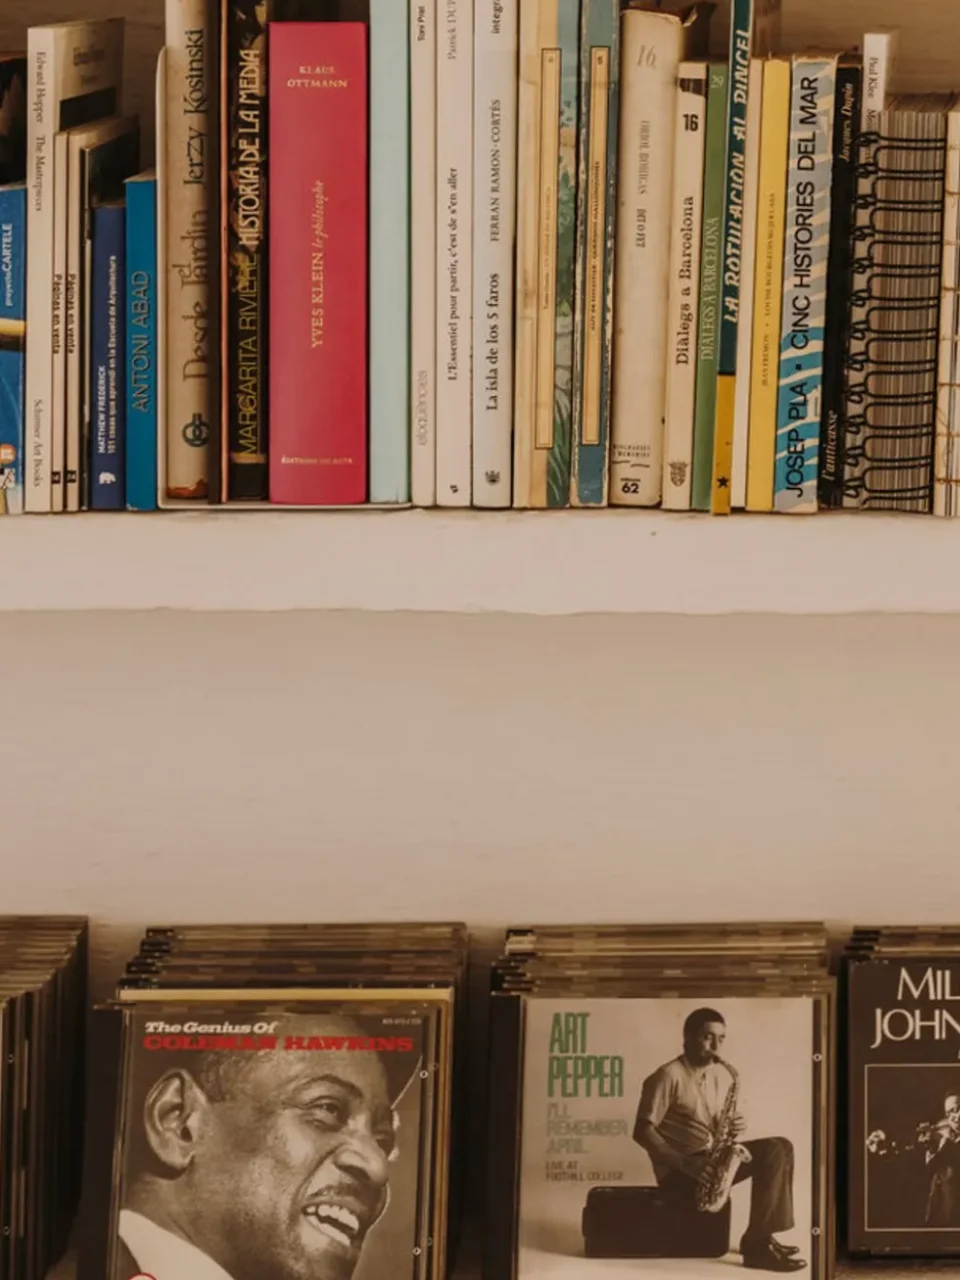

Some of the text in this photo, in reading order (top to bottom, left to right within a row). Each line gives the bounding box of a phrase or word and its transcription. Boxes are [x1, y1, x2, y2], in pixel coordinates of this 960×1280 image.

[287, 78, 348, 88] OTTMANN
[182, 28, 208, 190] Jerzy Kosinski
[682, 113, 699, 132] 16
[33, 51, 46, 212] Edward Hopper The Masterpieces
[238, 49, 260, 245] HISTORIA DE LA MEDIA
[446, 168, 458, 191] aller
[446, 219, 458, 231] de
[489, 197, 501, 242] FERRAN
[311, 252, 324, 303] KLEIN
[484, 274, 500, 309] faros
[676, 196, 695, 365] Diàlegs a Barcelona
[785, 76, 818, 498] JOSEP PLA CINC HISTORIES DEL MAR
[447, 296, 460, 320] pour
[132, 271, 150, 412] ANTONI ABAD
[182, 301, 209, 382] Desde
[311, 307, 324, 348] YVES
[484, 324, 499, 345] los
[484, 349, 499, 365] de
[237, 337, 258, 456] MARGARITA
[485, 368, 499, 392] isla
[97, 365, 106, 454] MATTHEW FREDERICK
[485, 396, 499, 411] La
[621, 482, 640, 494] 62
[143, 1035, 414, 1052] COLEMAN HAWKINS
[144, 1021, 279, 1035] The Genius Of
[549, 1012, 591, 1054] ART
[547, 1054, 625, 1098] PEPPER
[546, 1119, 628, 1138] REMEMBER
